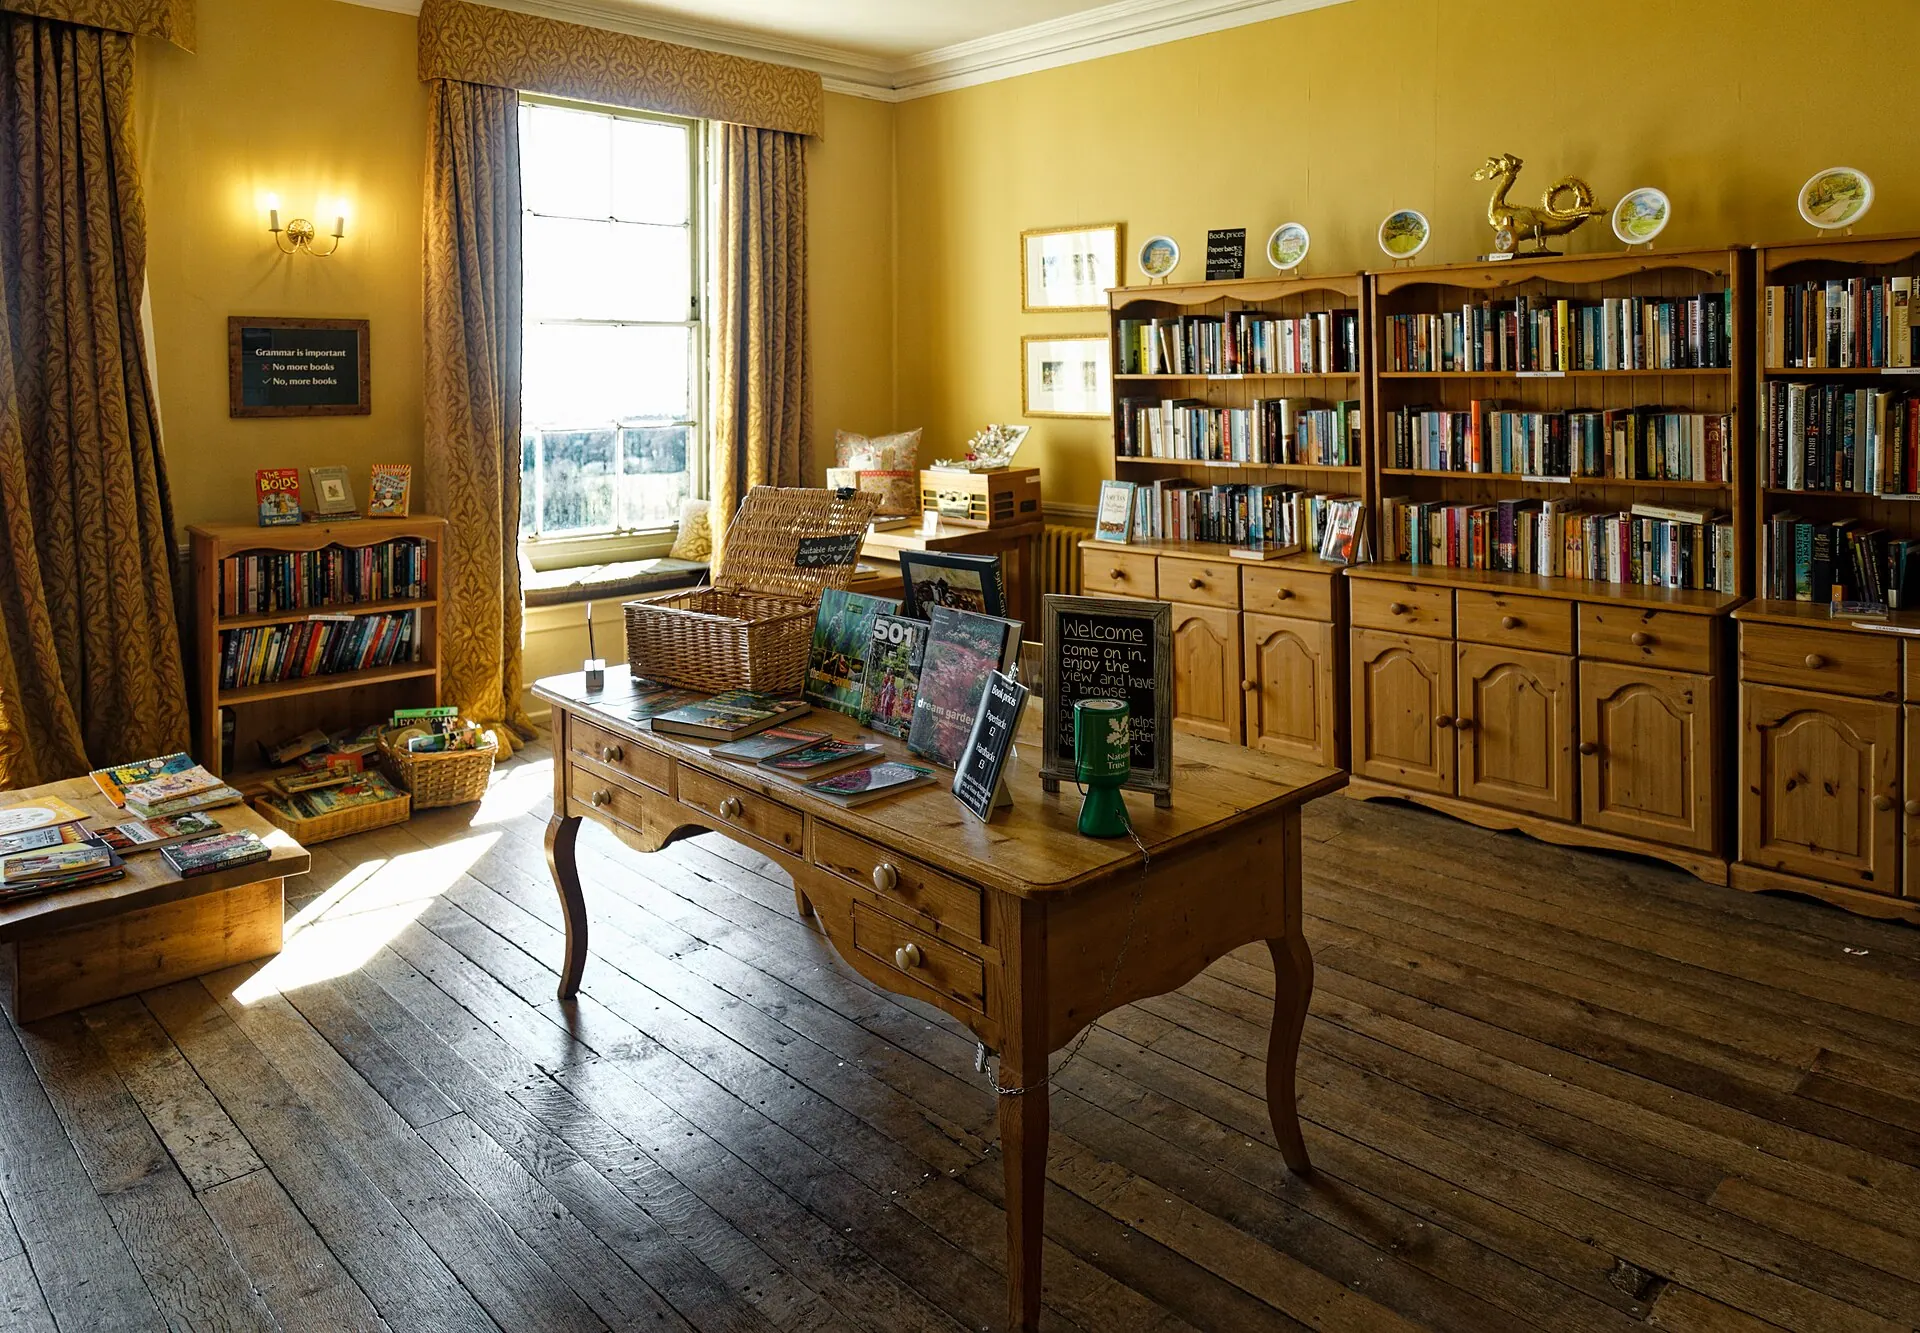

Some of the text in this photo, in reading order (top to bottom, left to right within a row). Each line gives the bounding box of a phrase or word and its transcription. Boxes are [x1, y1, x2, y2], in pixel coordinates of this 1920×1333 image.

[1208, 245, 1243, 254] Paperbacks
[255, 348, 346, 358] Grammar is important
[272, 363, 286, 371] No
[310, 363, 335, 371] books
[272, 377, 288, 386] No,
[312, 377, 337, 385] books
[263, 471, 280, 480] THE
[260, 476, 299, 491] BOLDS
[799, 546, 826, 555] Suitable
[827, 544, 837, 553] for
[873, 619, 914, 647] 501
[1063, 618, 1143, 642] Welcome
[1103, 648, 1121, 660] on
[1062, 656, 1130, 673] enjoy the
[1061, 669, 1155, 690] view and have
[991, 684, 1017, 708] Book prices
[1061, 681, 1131, 699] a browse.
[917, 698, 944, 717] dream
[985, 709, 1007, 730] Paperbacks
[1129, 729, 1154, 743] after
[976, 741, 995, 763] Hardbacks
[1107, 752, 1130, 762] Nation
[1107, 761, 1125, 770] Trust
